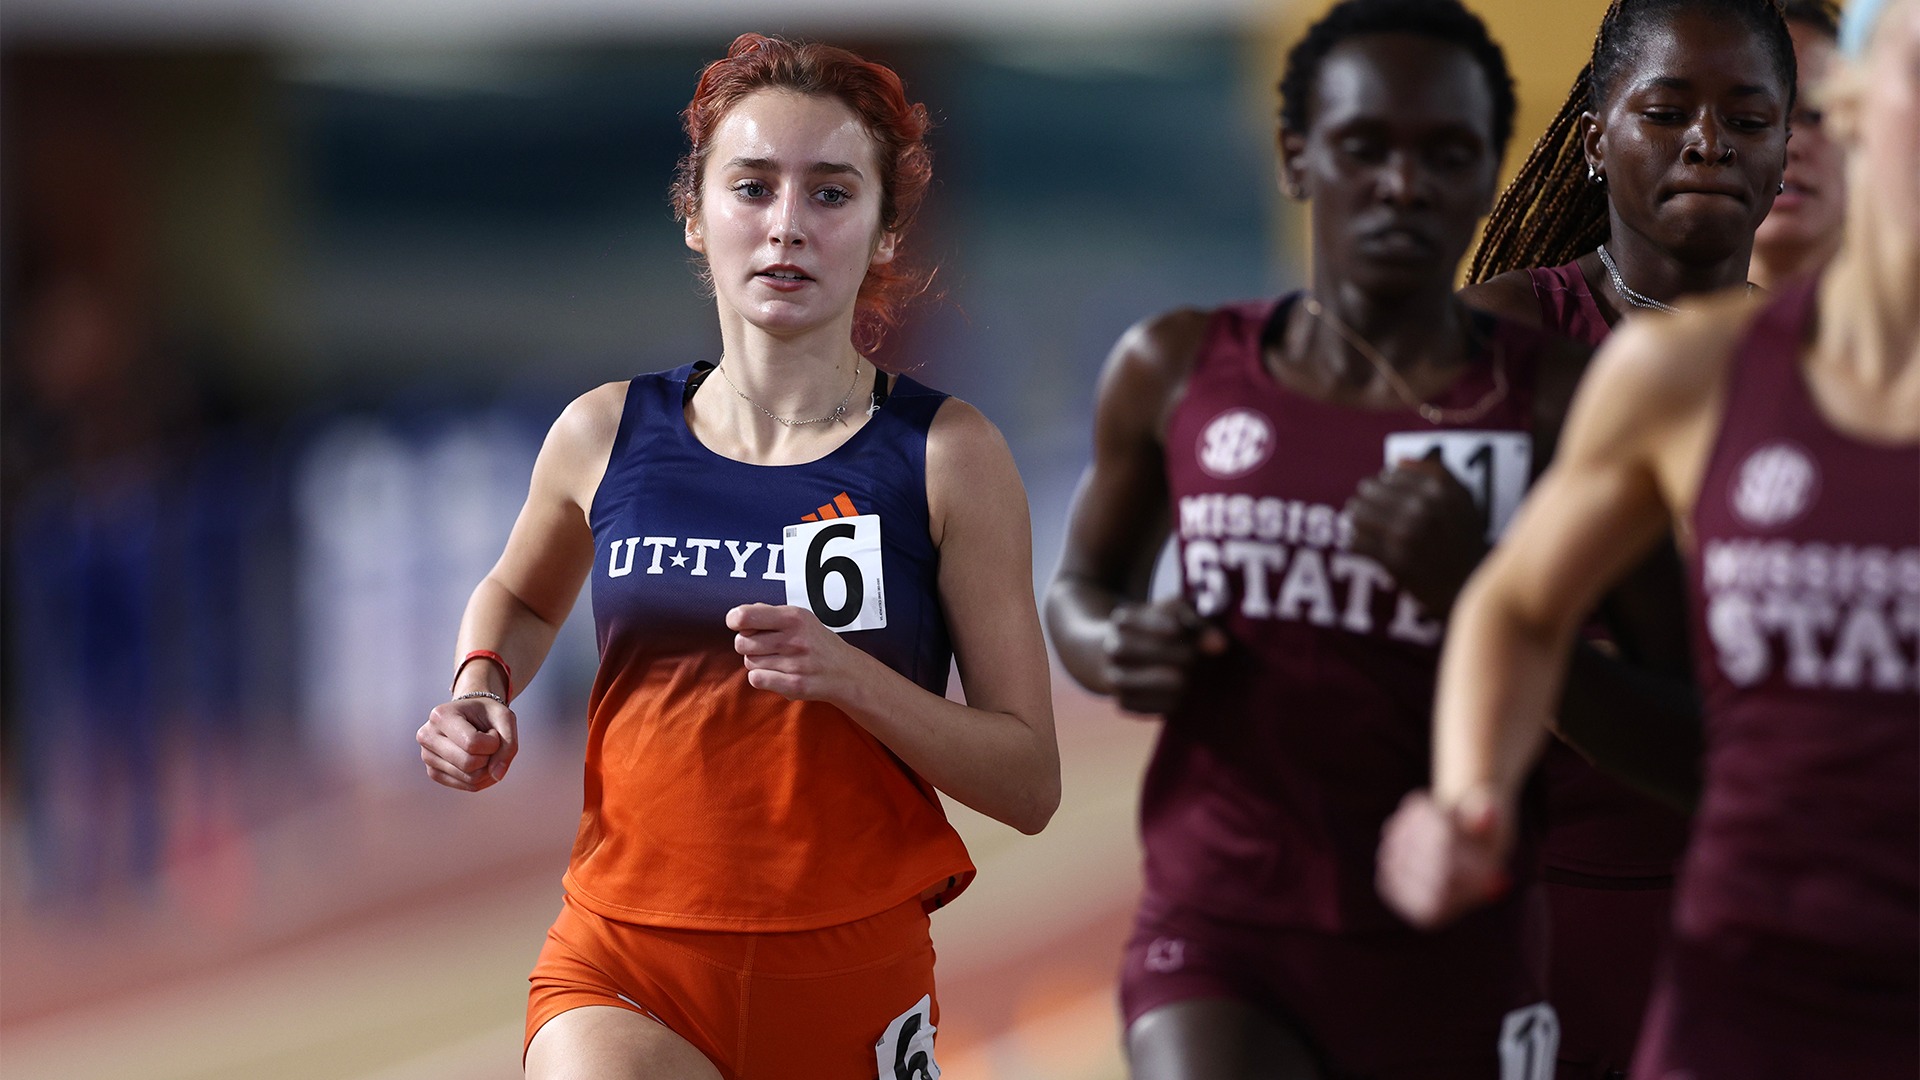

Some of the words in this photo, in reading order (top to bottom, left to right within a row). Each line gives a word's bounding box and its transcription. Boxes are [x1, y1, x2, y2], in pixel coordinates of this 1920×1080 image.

[608, 537, 677, 578] UT
[805, 523, 864, 628] 6
[894, 1012, 933, 1080] 6
